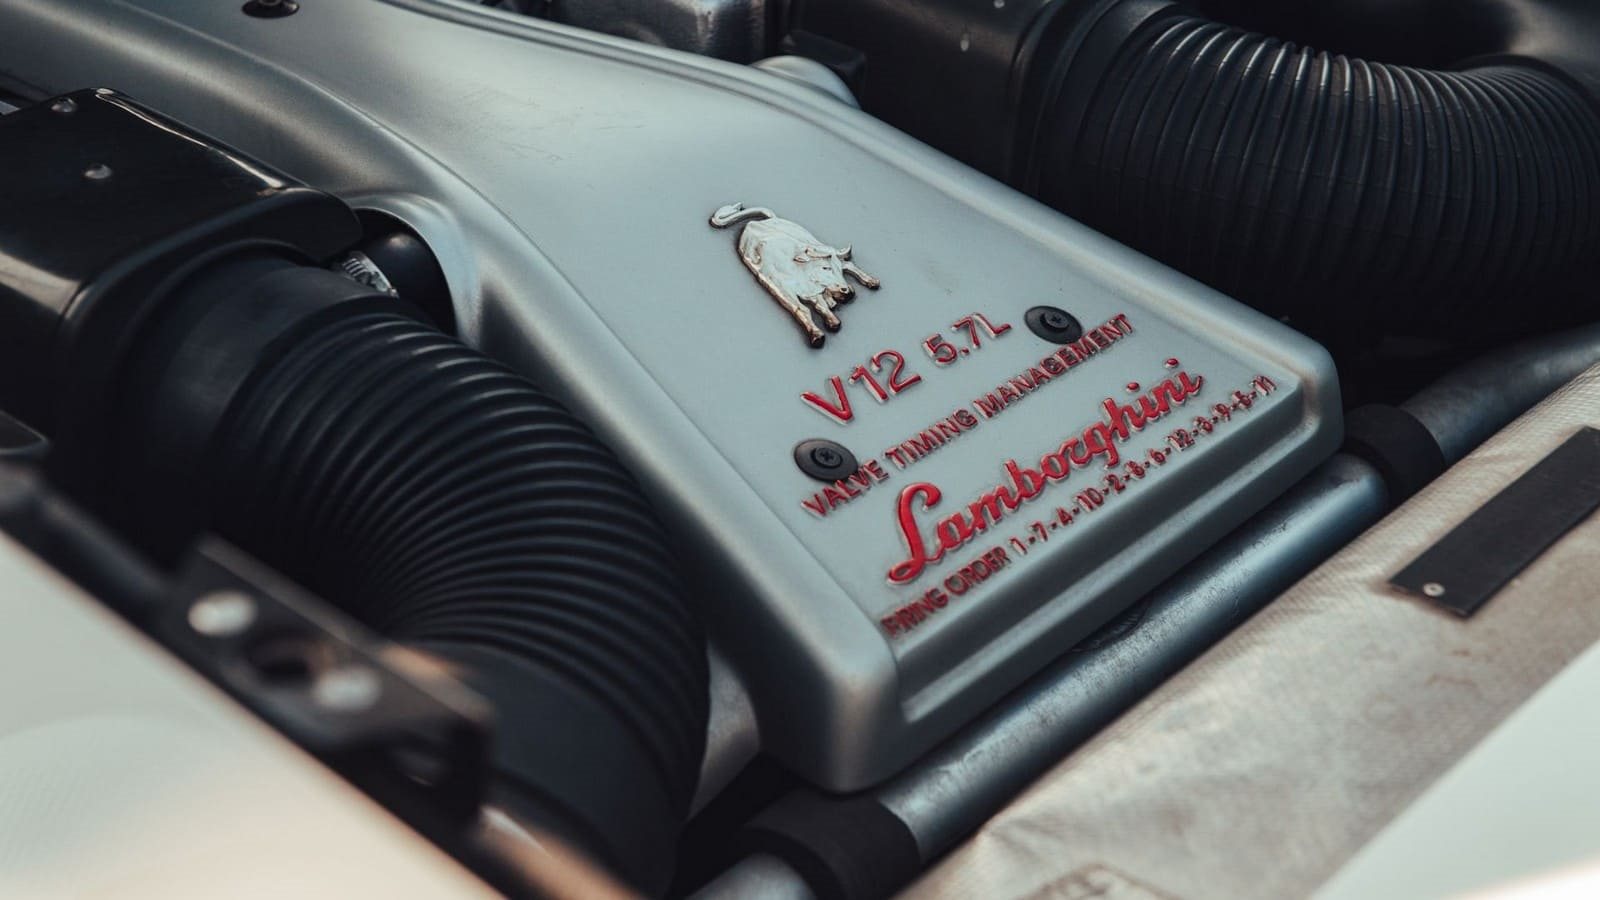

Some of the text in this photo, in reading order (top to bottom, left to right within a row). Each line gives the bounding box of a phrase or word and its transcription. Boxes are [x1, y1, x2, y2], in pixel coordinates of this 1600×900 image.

[801, 312, 1012, 425] V12 5.7L
[801, 313, 1134, 517] VALVE TIMING MANAGEMENT
[887, 358, 1204, 583] Lamborghini
[944, 546, 1011, 596] ORDER
